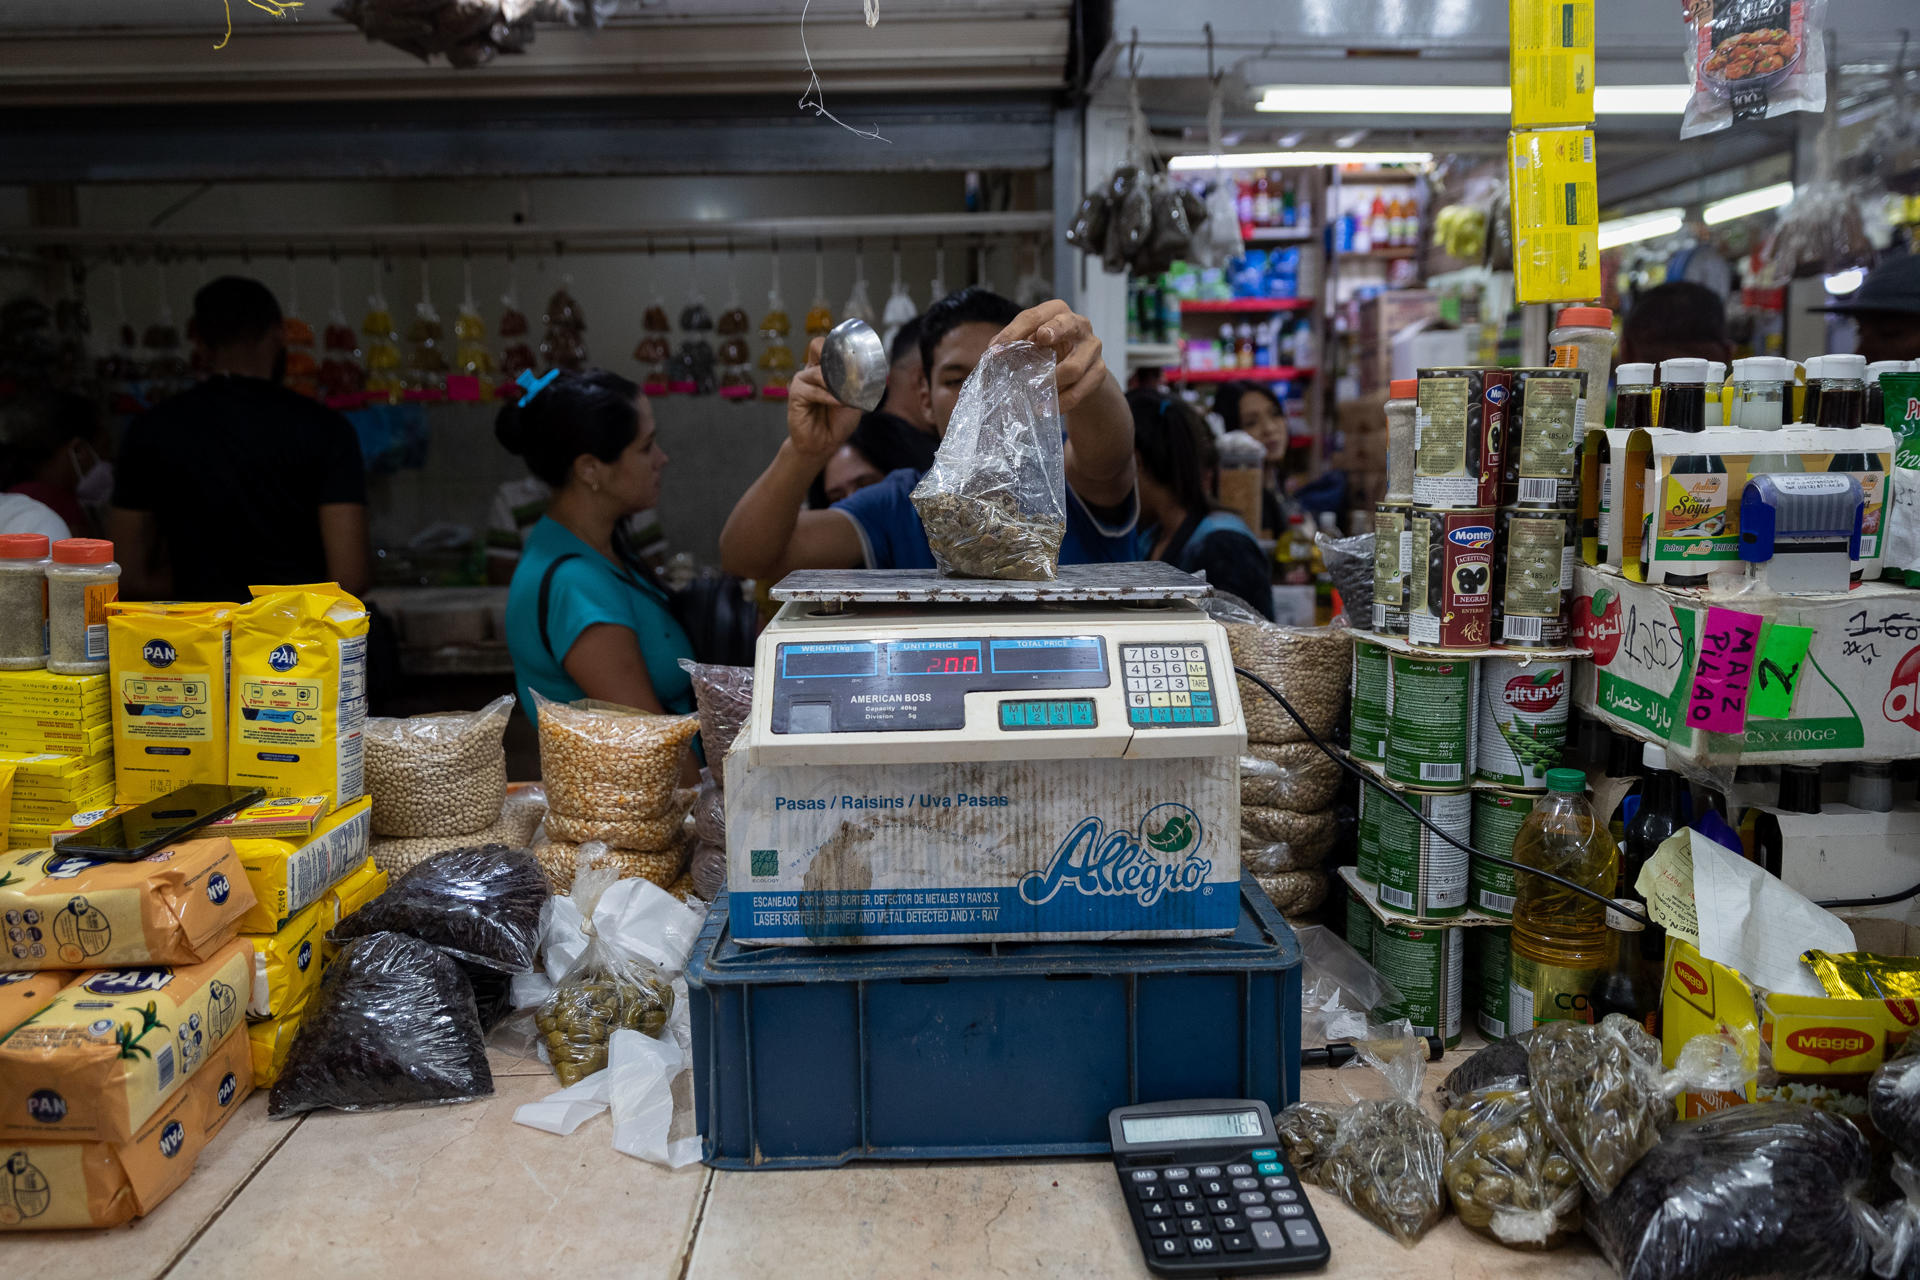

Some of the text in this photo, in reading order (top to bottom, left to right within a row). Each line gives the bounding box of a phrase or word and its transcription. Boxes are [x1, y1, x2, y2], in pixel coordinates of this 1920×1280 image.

[1671, 495, 1711, 518] Soya
[1455, 530, 1493, 542] Montey
[1460, 595, 1486, 604] NEGRAS
[928, 641, 960, 649] PRICE
[1017, 639, 1068, 648] TOTAL PRICE
[1129, 649, 1138, 659] 7
[1150, 649, 1159, 659] 8
[1170, 649, 1179, 659] 9
[1190, 649, 1199, 659] C
[1131, 664, 1140, 674] 4
[1152, 664, 1161, 674] 5
[1172, 663, 1182, 673] 6
[1189, 664, 1204, 673] M+
[1134, 680, 1140, 689] 1
[1153, 679, 1163, 689] 2
[1175, 679, 1184, 689] 3
[1191, 679, 1207, 688] TARE
[850, 693, 932, 704] AMERICAN BOSS
[1175, 694, 1187, 704] M
[865, 704, 917, 713] Capacity 40kg
[775, 796, 826, 811] Pasas
[841, 794, 904, 810] Raisins
[919, 794, 950, 808] Uva
[957, 792, 1009, 808] Pasas
[1019, 817, 1210, 907] Allegro
[753, 895, 798, 908] ESCANEADO
[841, 894, 873, 907] SORTER,
[874, 893, 913, 906] DETECTOR
[913, 893, 924, 905] DE
[924, 892, 958, 905] METALES
[958, 892, 965, 904] Y
[966, 891, 993, 904] RAYOS
[993, 891, 999, 903] X
[753, 912, 782, 927] LASER
[782, 911, 816, 926] SORTER
[817, 911, 858, 925] SCANNER
[858, 911, 875, 925] AND
[876, 910, 905, 924] METAL
[906, 909, 950, 923] DETECTED
[950, 909, 969, 922] AND
[969, 909, 975, 922] X
[981, 908, 999, 922] RAY
[1676, 964, 1705, 991] Maggi
[1797, 1034, 1864, 1051] Maggi
[1145, 1186, 1156, 1197] 7
[1178, 1184, 1189, 1195] 8
[1210, 1182, 1220, 1193] 9
[1152, 1203, 1162, 1214] 4
[1184, 1201, 1195, 1212] 5
[1217, 1199, 1228, 1210] 6
[1159, 1221, 1167, 1232] 1
[1191, 1219, 1202, 1231] 2
[1224, 1217, 1235, 1229] 3
[1163, 1240, 1175, 1251] 0
[1193, 1238, 1213, 1249] 00
